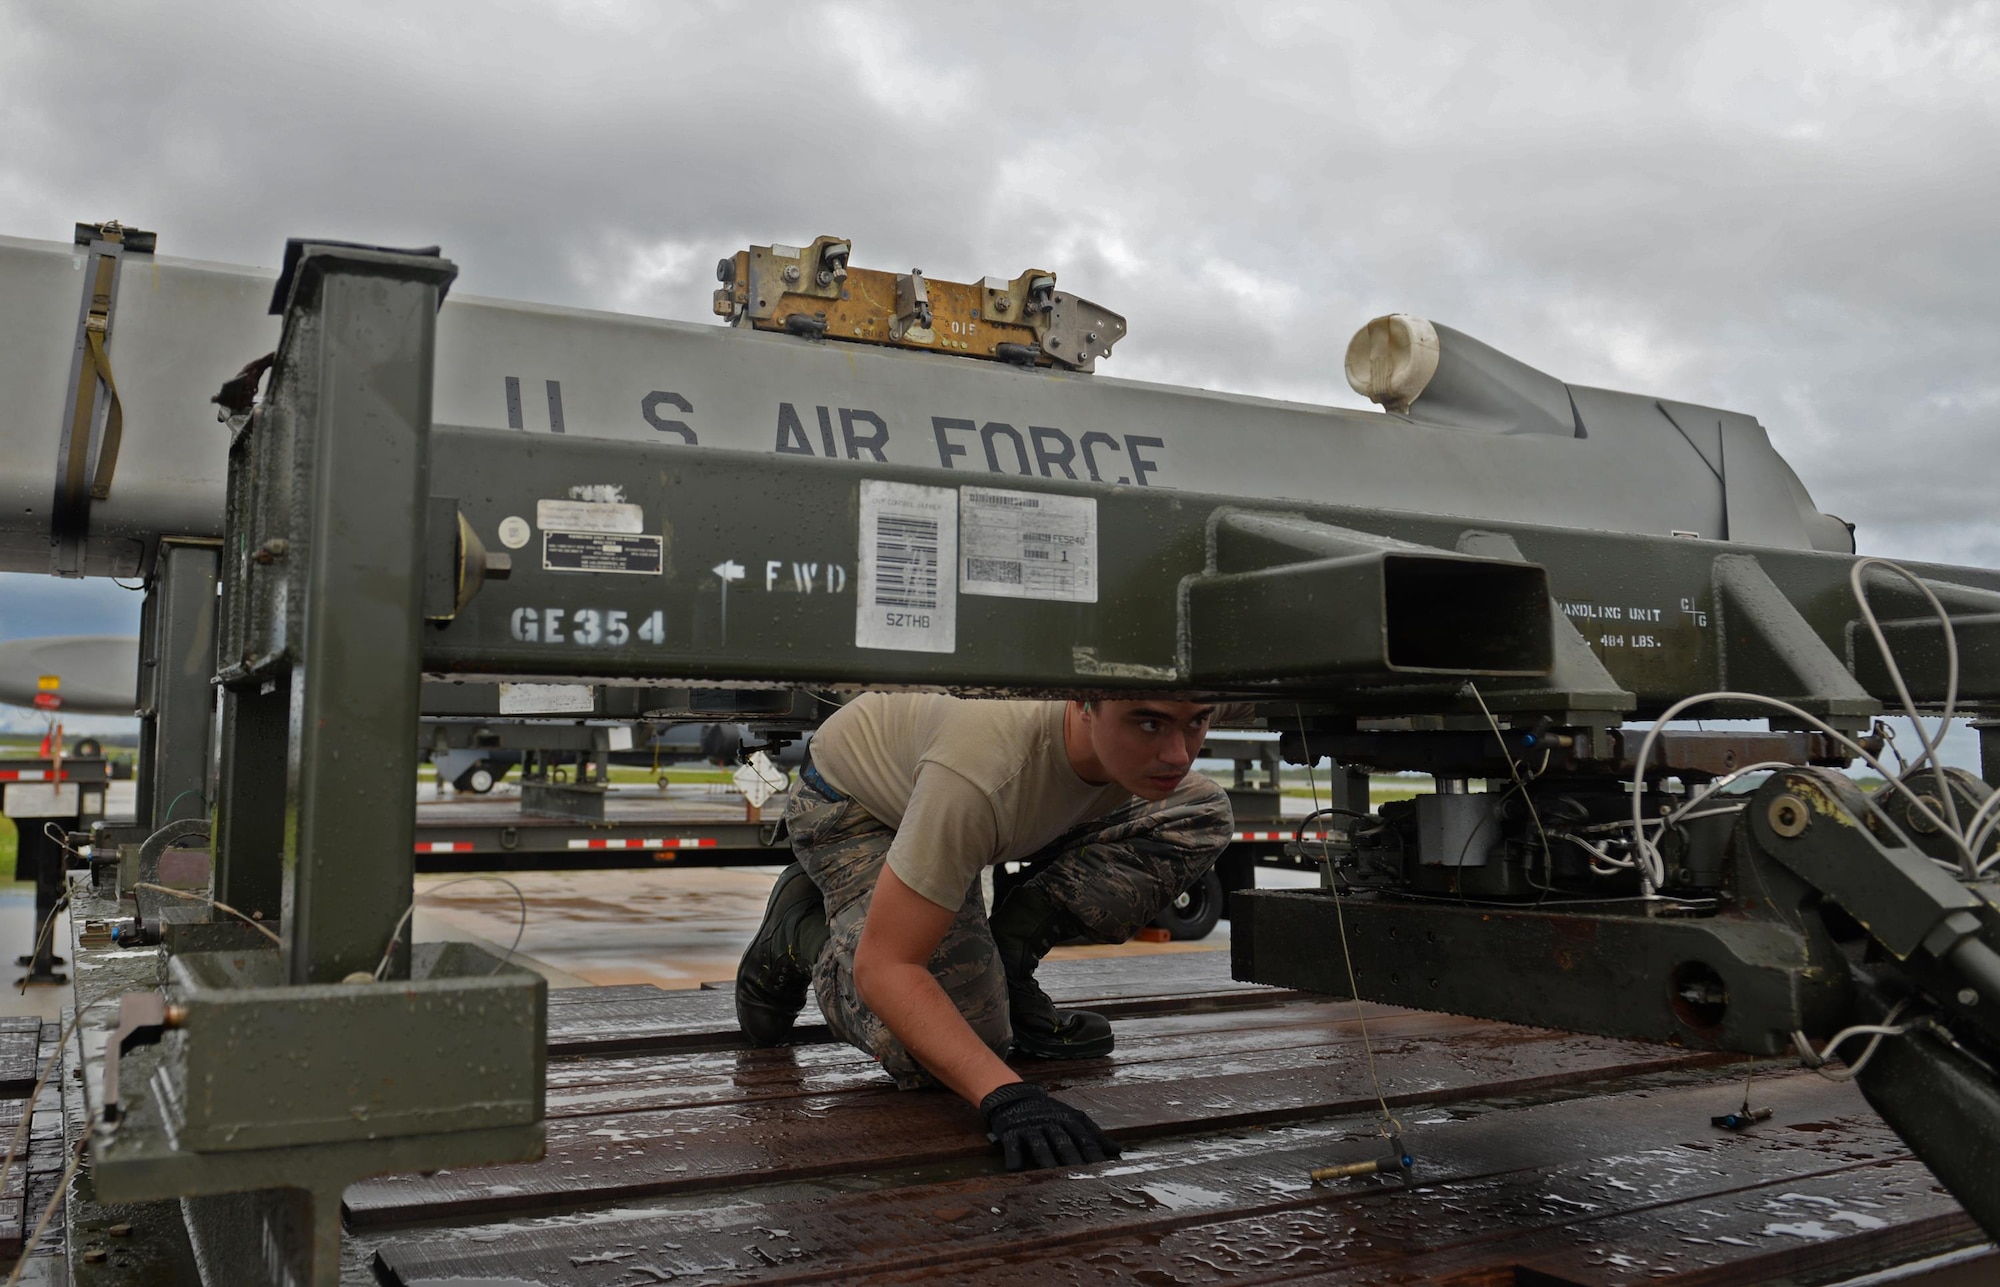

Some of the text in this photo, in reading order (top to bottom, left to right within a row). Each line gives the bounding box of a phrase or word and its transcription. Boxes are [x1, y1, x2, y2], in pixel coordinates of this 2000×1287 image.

[775, 402, 890, 463] AIR
[931, 416, 1166, 487] FORCE
[1061, 550, 1069, 562] 1
[1559, 603, 1661, 622] ANDLING UNIT
[1600, 634, 1624, 647] 484
[1631, 635, 1661, 648] LBS.
